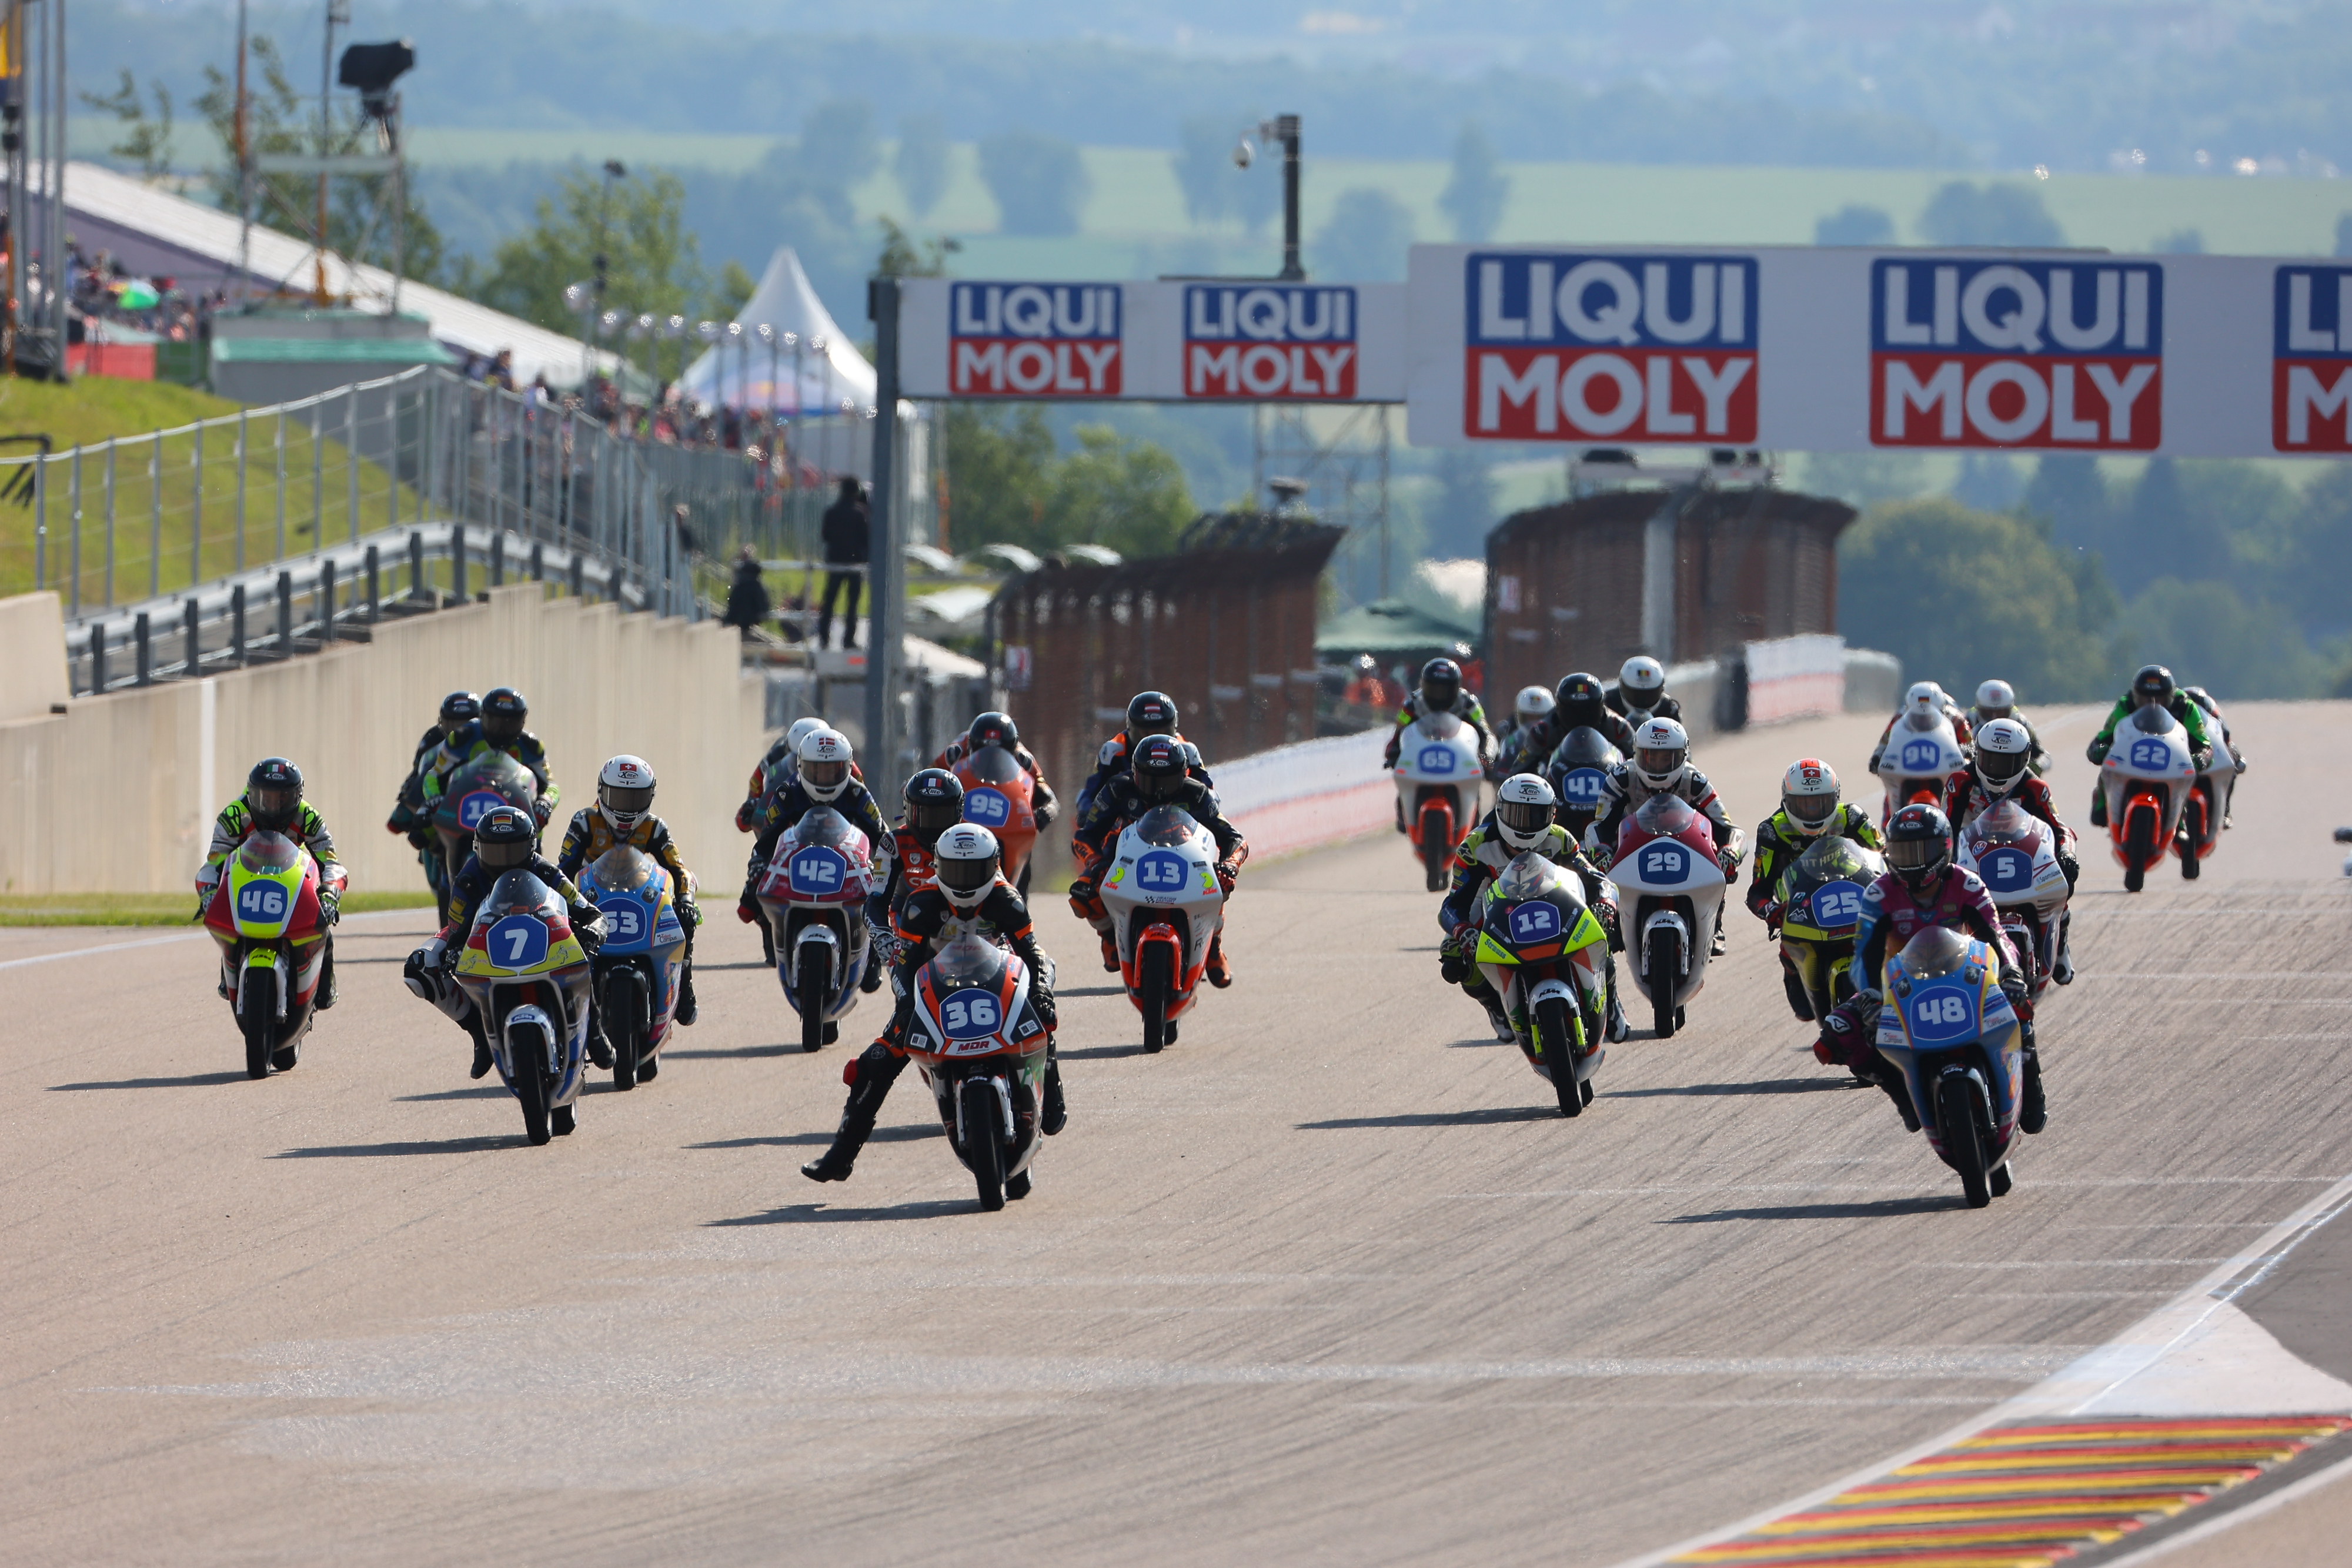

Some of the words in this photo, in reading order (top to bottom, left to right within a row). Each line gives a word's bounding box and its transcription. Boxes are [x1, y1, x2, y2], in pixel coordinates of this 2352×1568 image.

[957, 286, 1115, 338] LIQUI
[1191, 289, 1349, 340] LIQUI
[1479, 260, 1745, 346] LIQUI
[1885, 265, 2150, 353] LIQUI
[957, 342, 1117, 392] MOLY
[1191, 345, 1352, 394] MOLY
[1478, 352, 1754, 436] MOLY
[1883, 360, 2157, 442] MOLY
[1422, 752, 1451, 768] 65
[1903, 745, 1935, 764] 94
[2134, 745, 2166, 764] 22
[1568, 777, 1601, 795] 41
[970, 793, 1003, 818] 95
[799, 860, 836, 884] 42
[1142, 861, 1180, 883] 13
[1648, 852, 1682, 872] 29
[1997, 857, 2016, 878] 5
[242, 890, 282, 915] 46
[1821, 891, 1860, 918] 25
[1518, 911, 1551, 933] 12
[1572, 918, 1590, 943] Strauss
[505, 928, 528, 960] 7
[660, 935, 677, 943] Campus
[1484, 938, 1506, 959] Strauss
[1538, 988, 1561, 998] KTM
[946, 998, 995, 1030] 36
[1918, 996, 1966, 1025] 48
[957, 1040, 990, 1052] MDR
